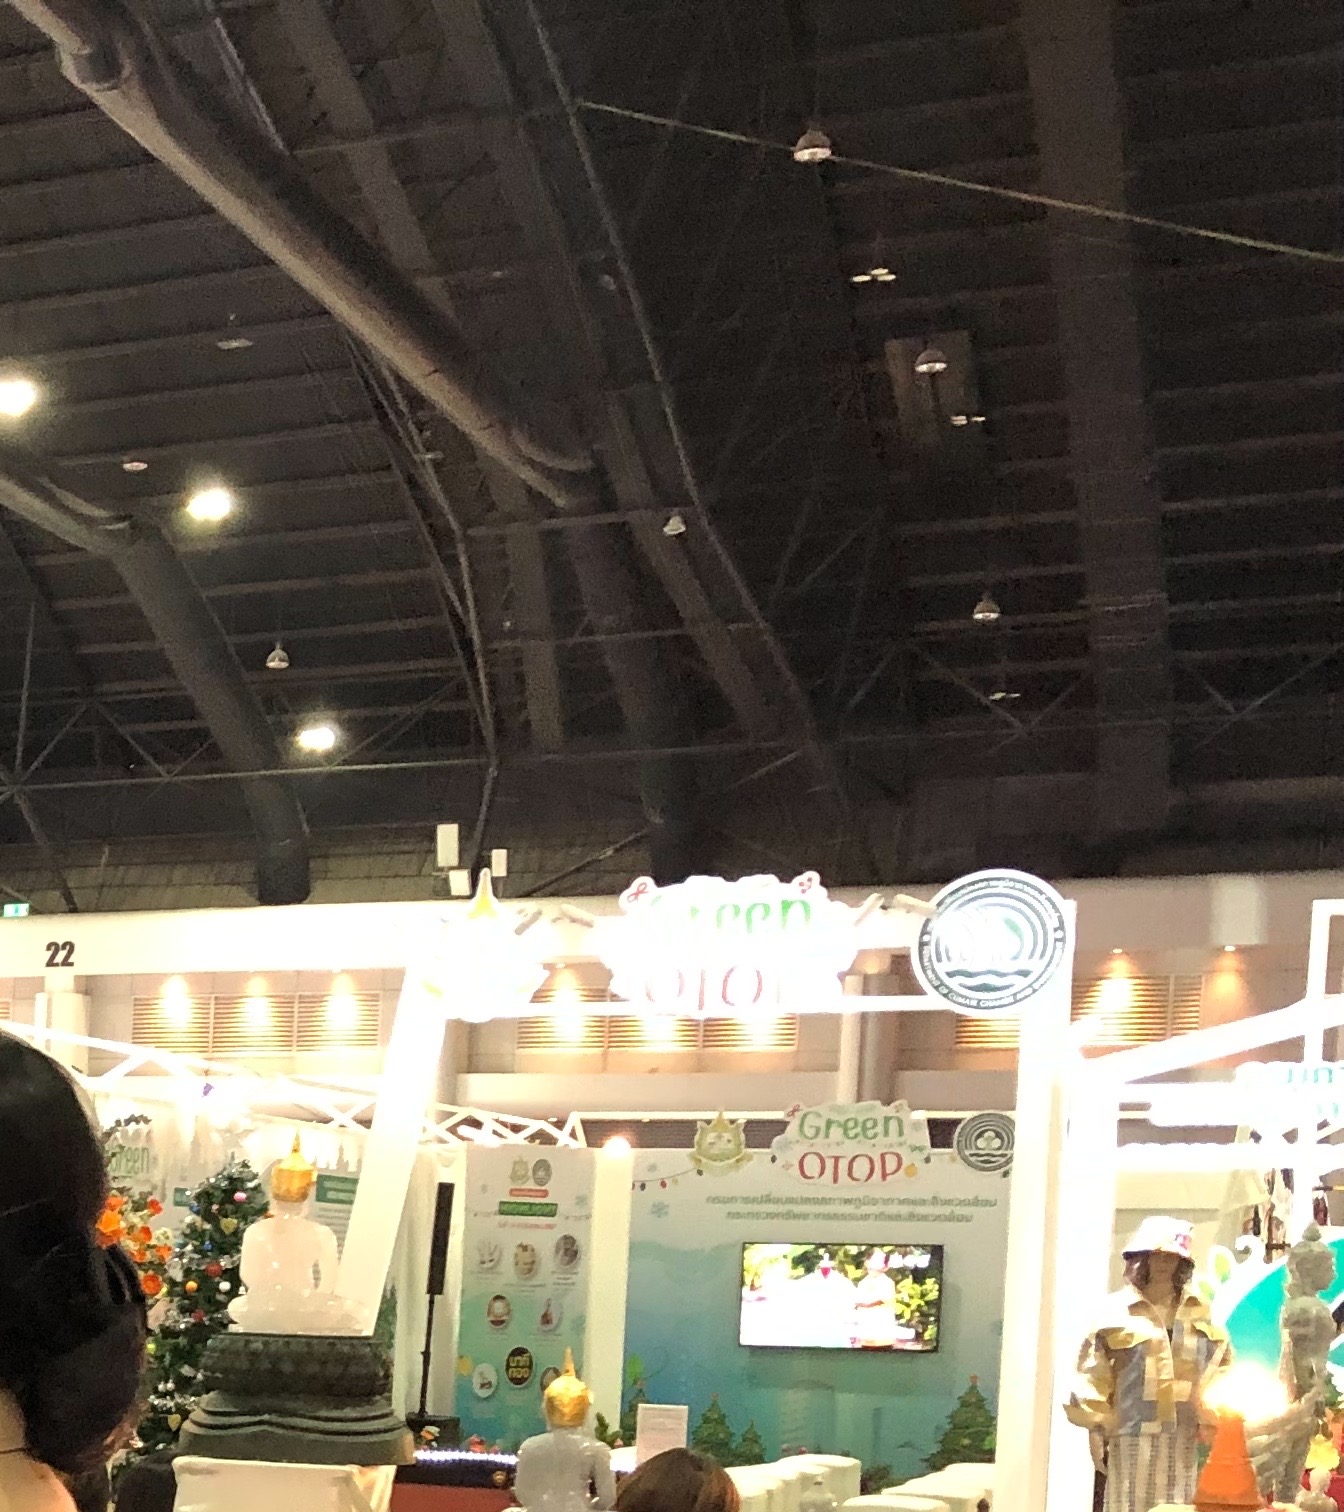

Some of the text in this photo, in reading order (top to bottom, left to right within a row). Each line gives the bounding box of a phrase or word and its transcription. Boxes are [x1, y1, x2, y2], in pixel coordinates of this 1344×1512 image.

[45, 941, 75, 967] 22
[798, 1110, 905, 1141] Green
[798, 1151, 904, 1185] OTOP
